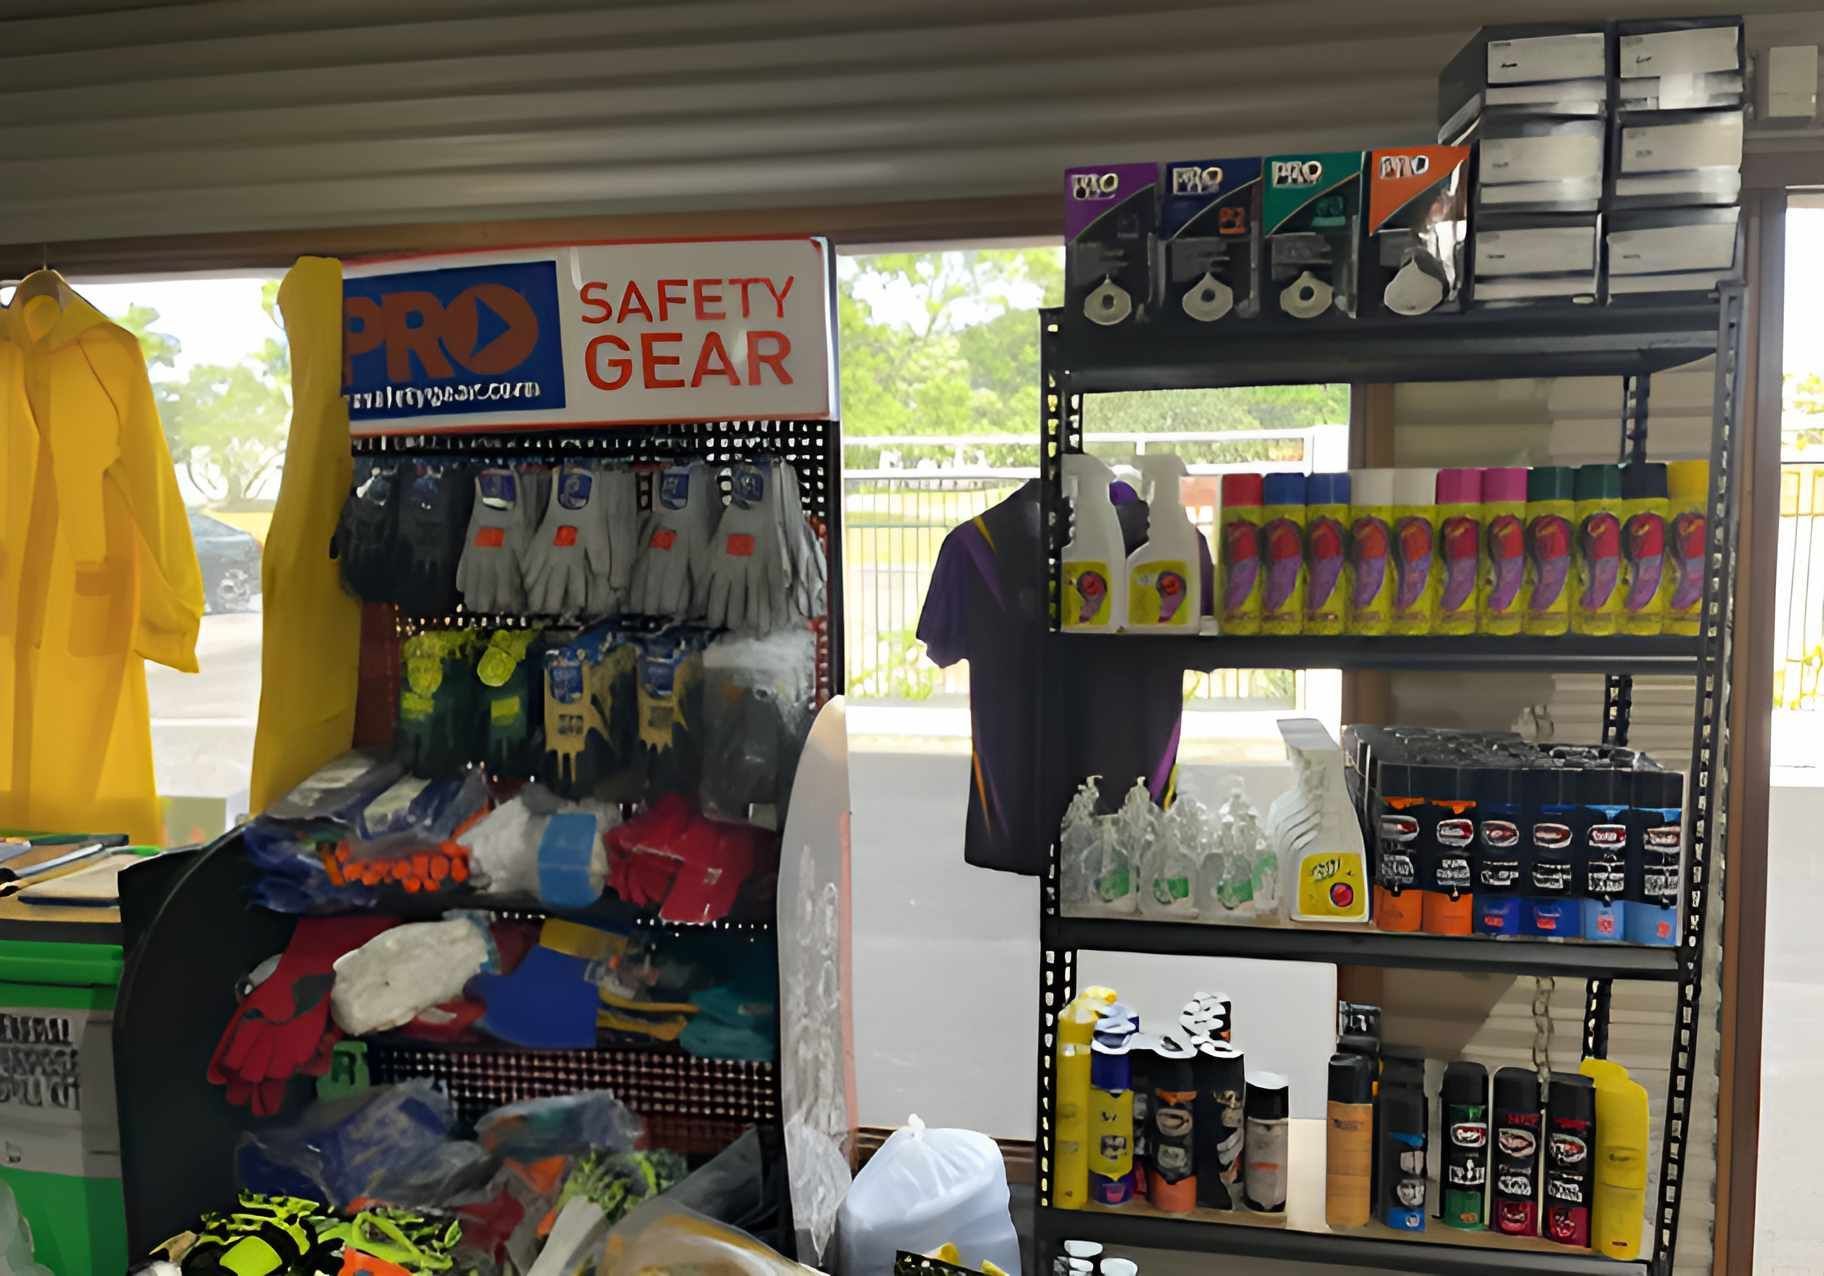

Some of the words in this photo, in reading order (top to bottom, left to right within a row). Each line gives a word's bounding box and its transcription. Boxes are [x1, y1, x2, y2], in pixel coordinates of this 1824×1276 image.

[580, 275, 794, 324] SAFETY
[342, 282, 539, 385] PRO
[585, 330, 793, 391] GEAR
